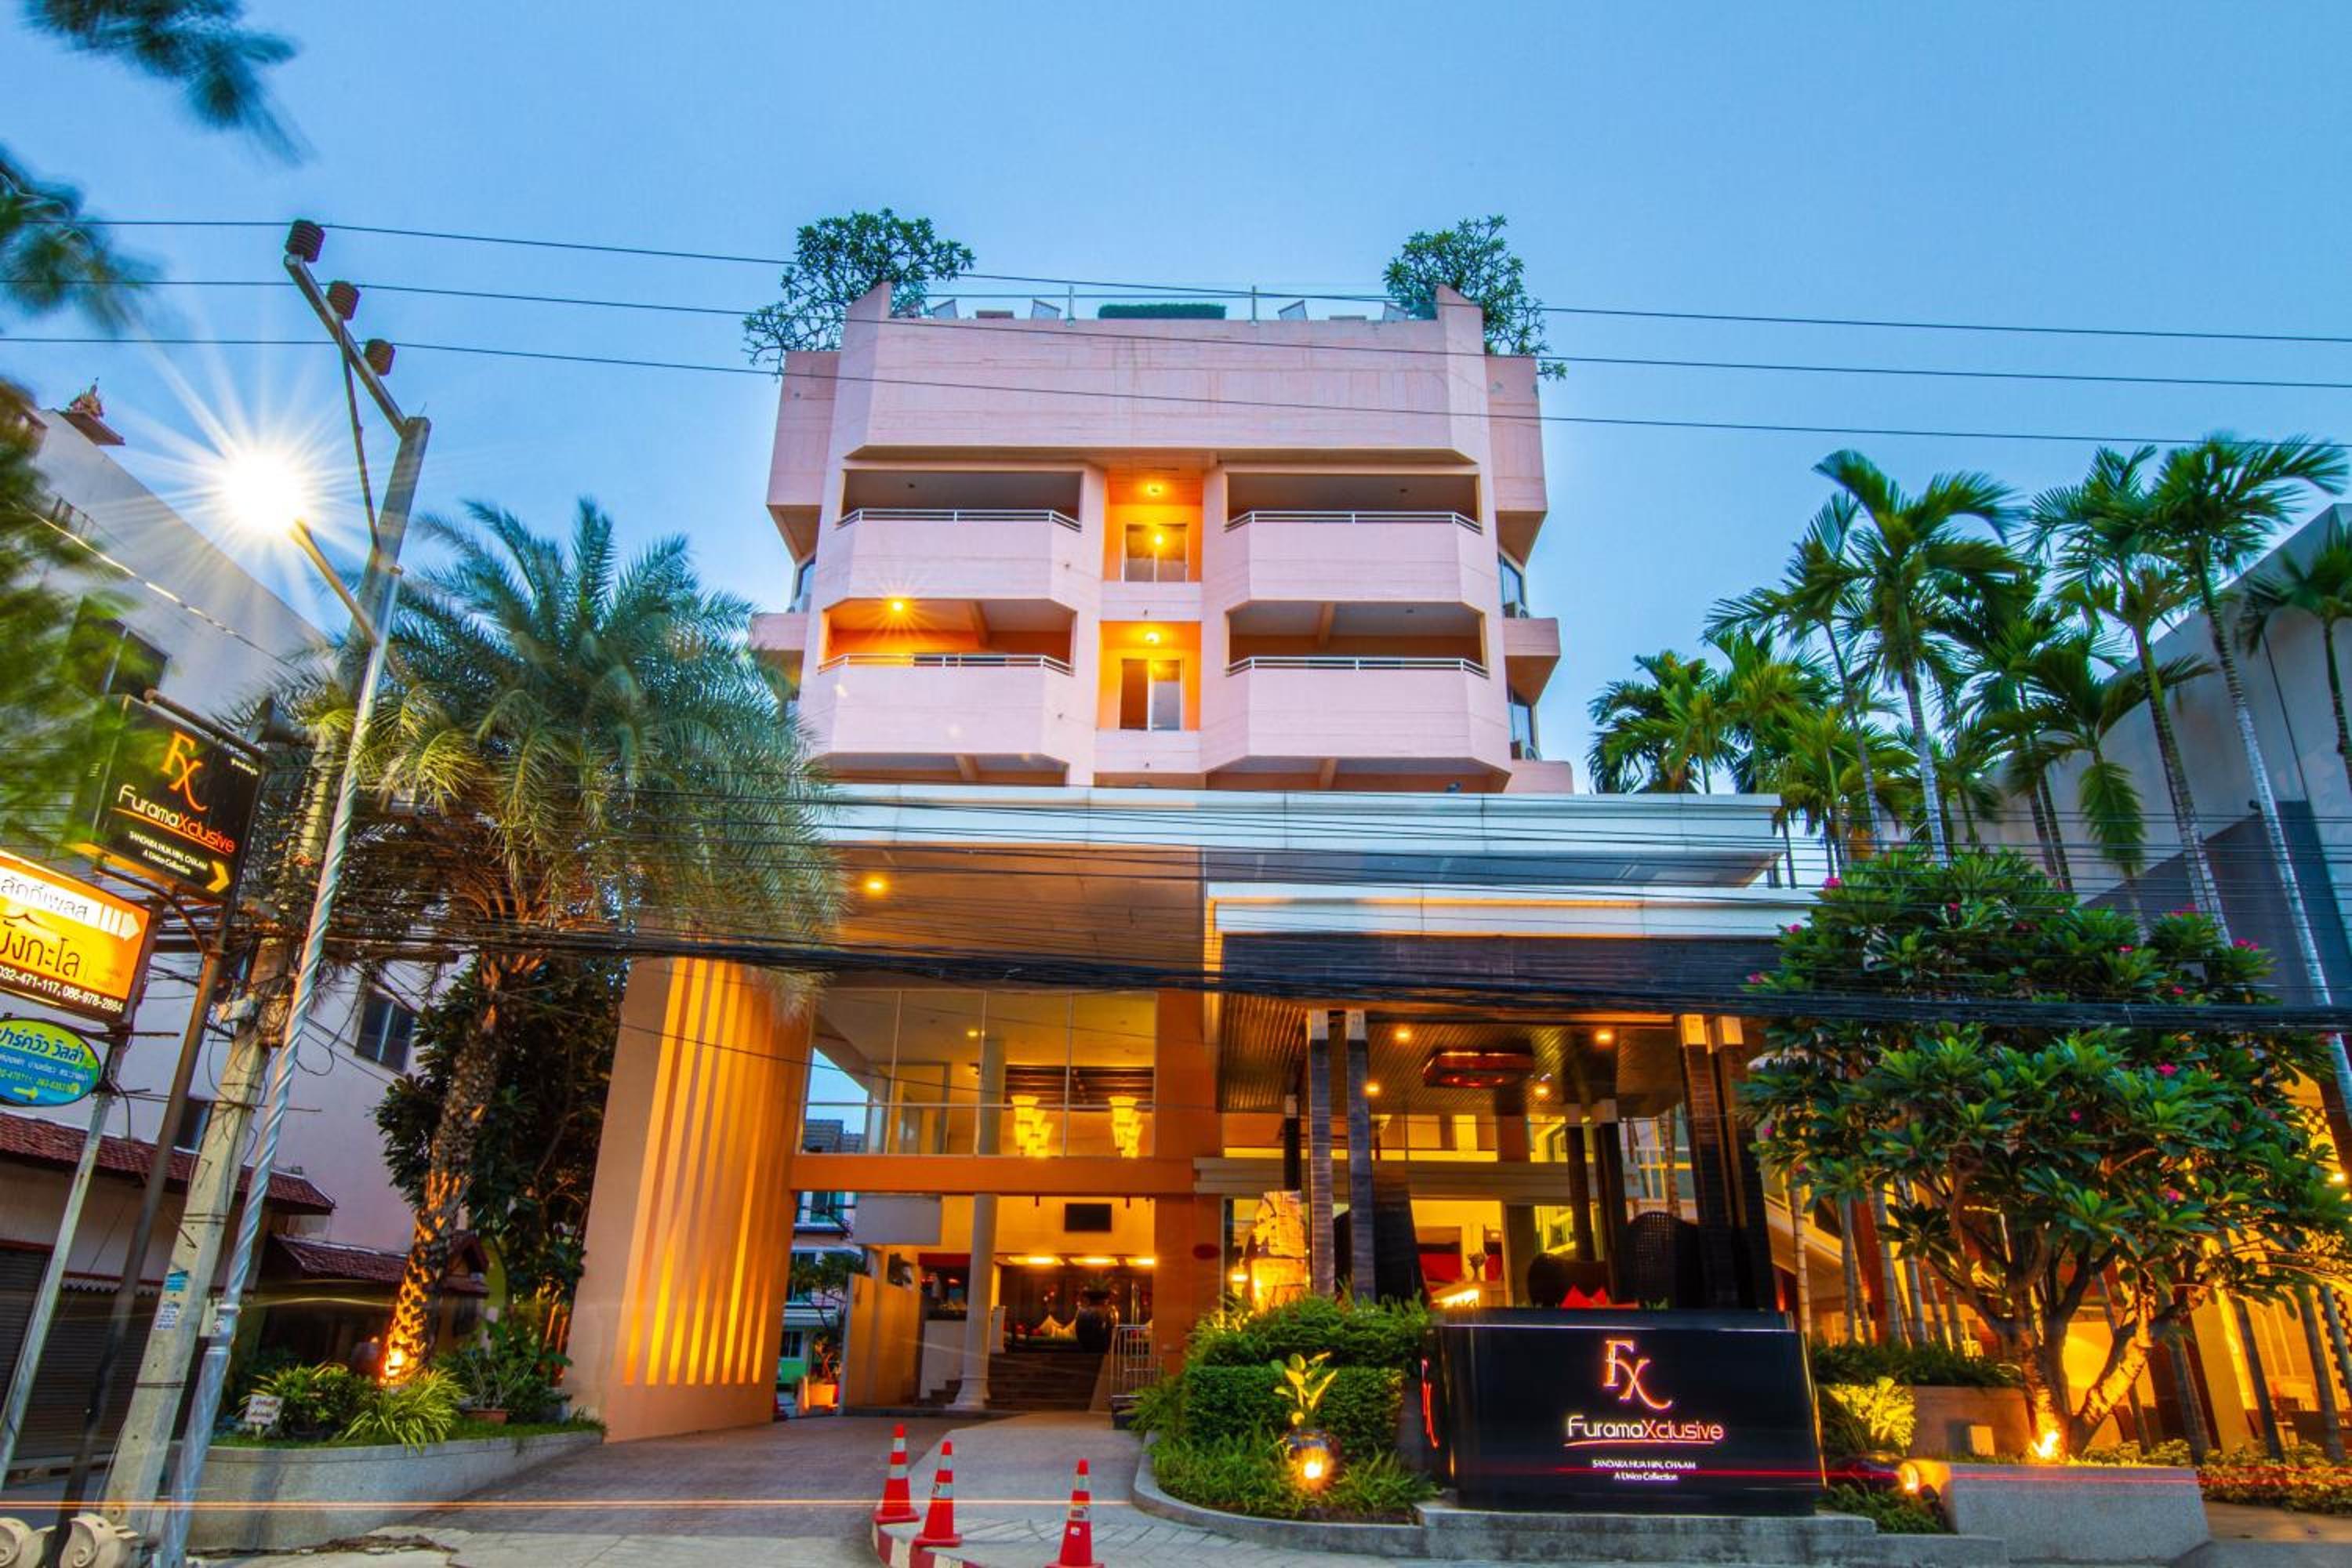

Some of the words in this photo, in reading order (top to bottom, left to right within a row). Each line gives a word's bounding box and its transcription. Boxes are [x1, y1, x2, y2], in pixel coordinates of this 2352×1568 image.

[118, 784, 235, 853] FuramaXclusive
[1567, 1414, 1725, 1441] FuramaXclusive
[1614, 1472, 1621, 1481] A
[1642, 1472, 1679, 1481] Collection
